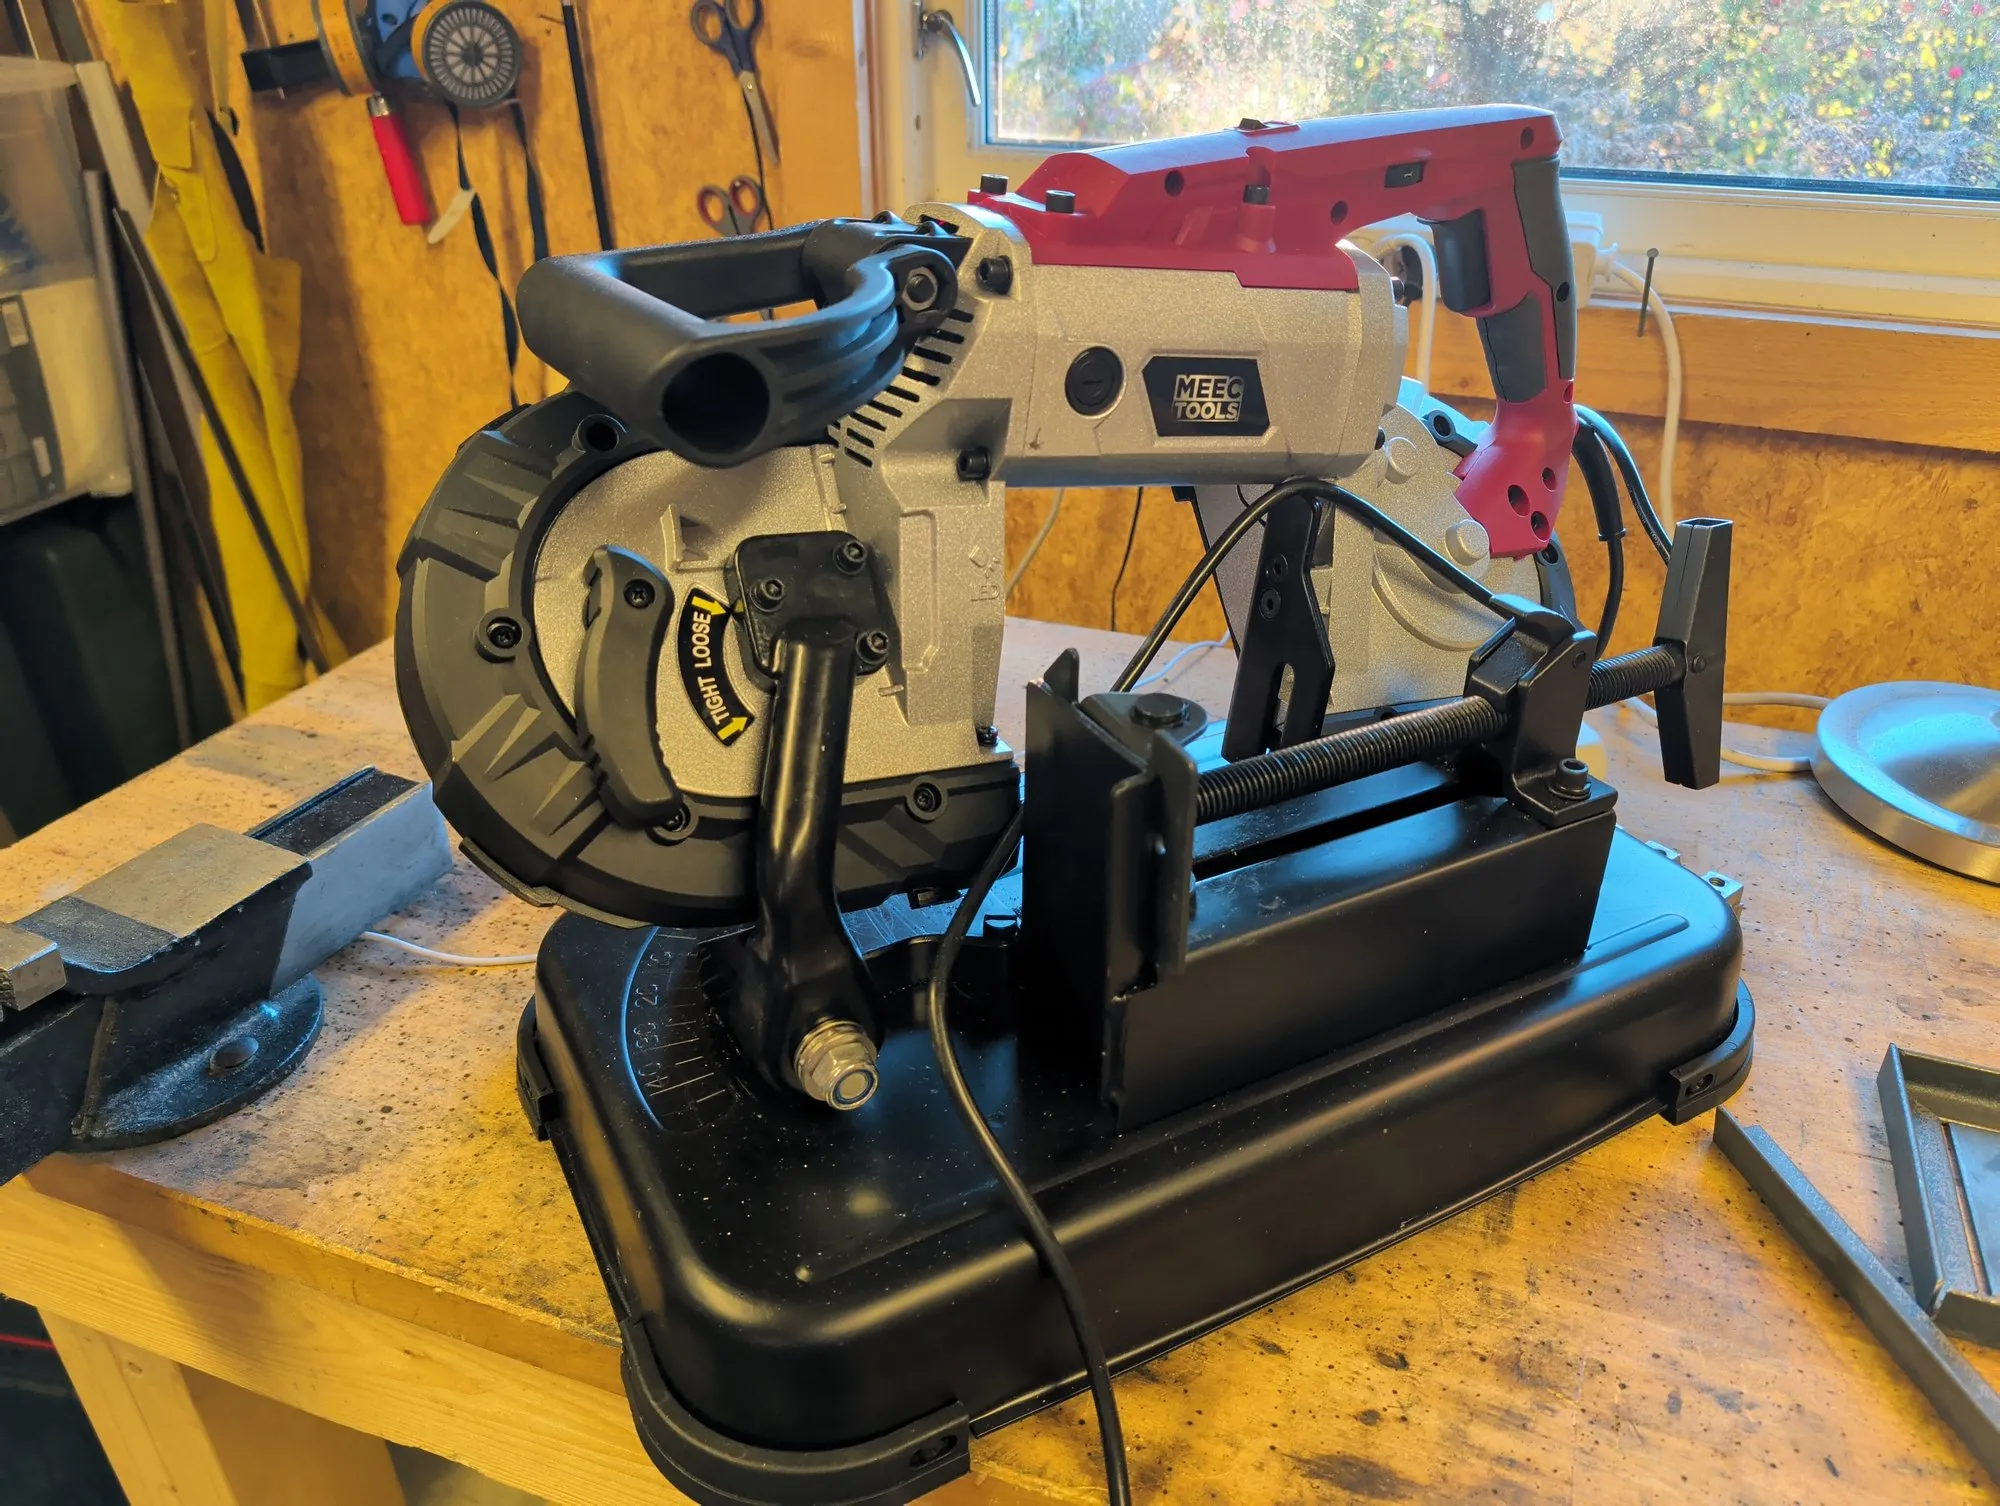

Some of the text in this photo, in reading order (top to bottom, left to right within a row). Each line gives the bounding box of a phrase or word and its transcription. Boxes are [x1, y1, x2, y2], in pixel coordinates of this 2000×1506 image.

[1175, 377, 1243, 399] MEEC
[1174, 402, 1239, 420] TOOLS
[969, 583, 1001, 602] LED
[691, 611, 730, 726] TIGHT LOOSE
[637, 1062, 669, 1088] 40
